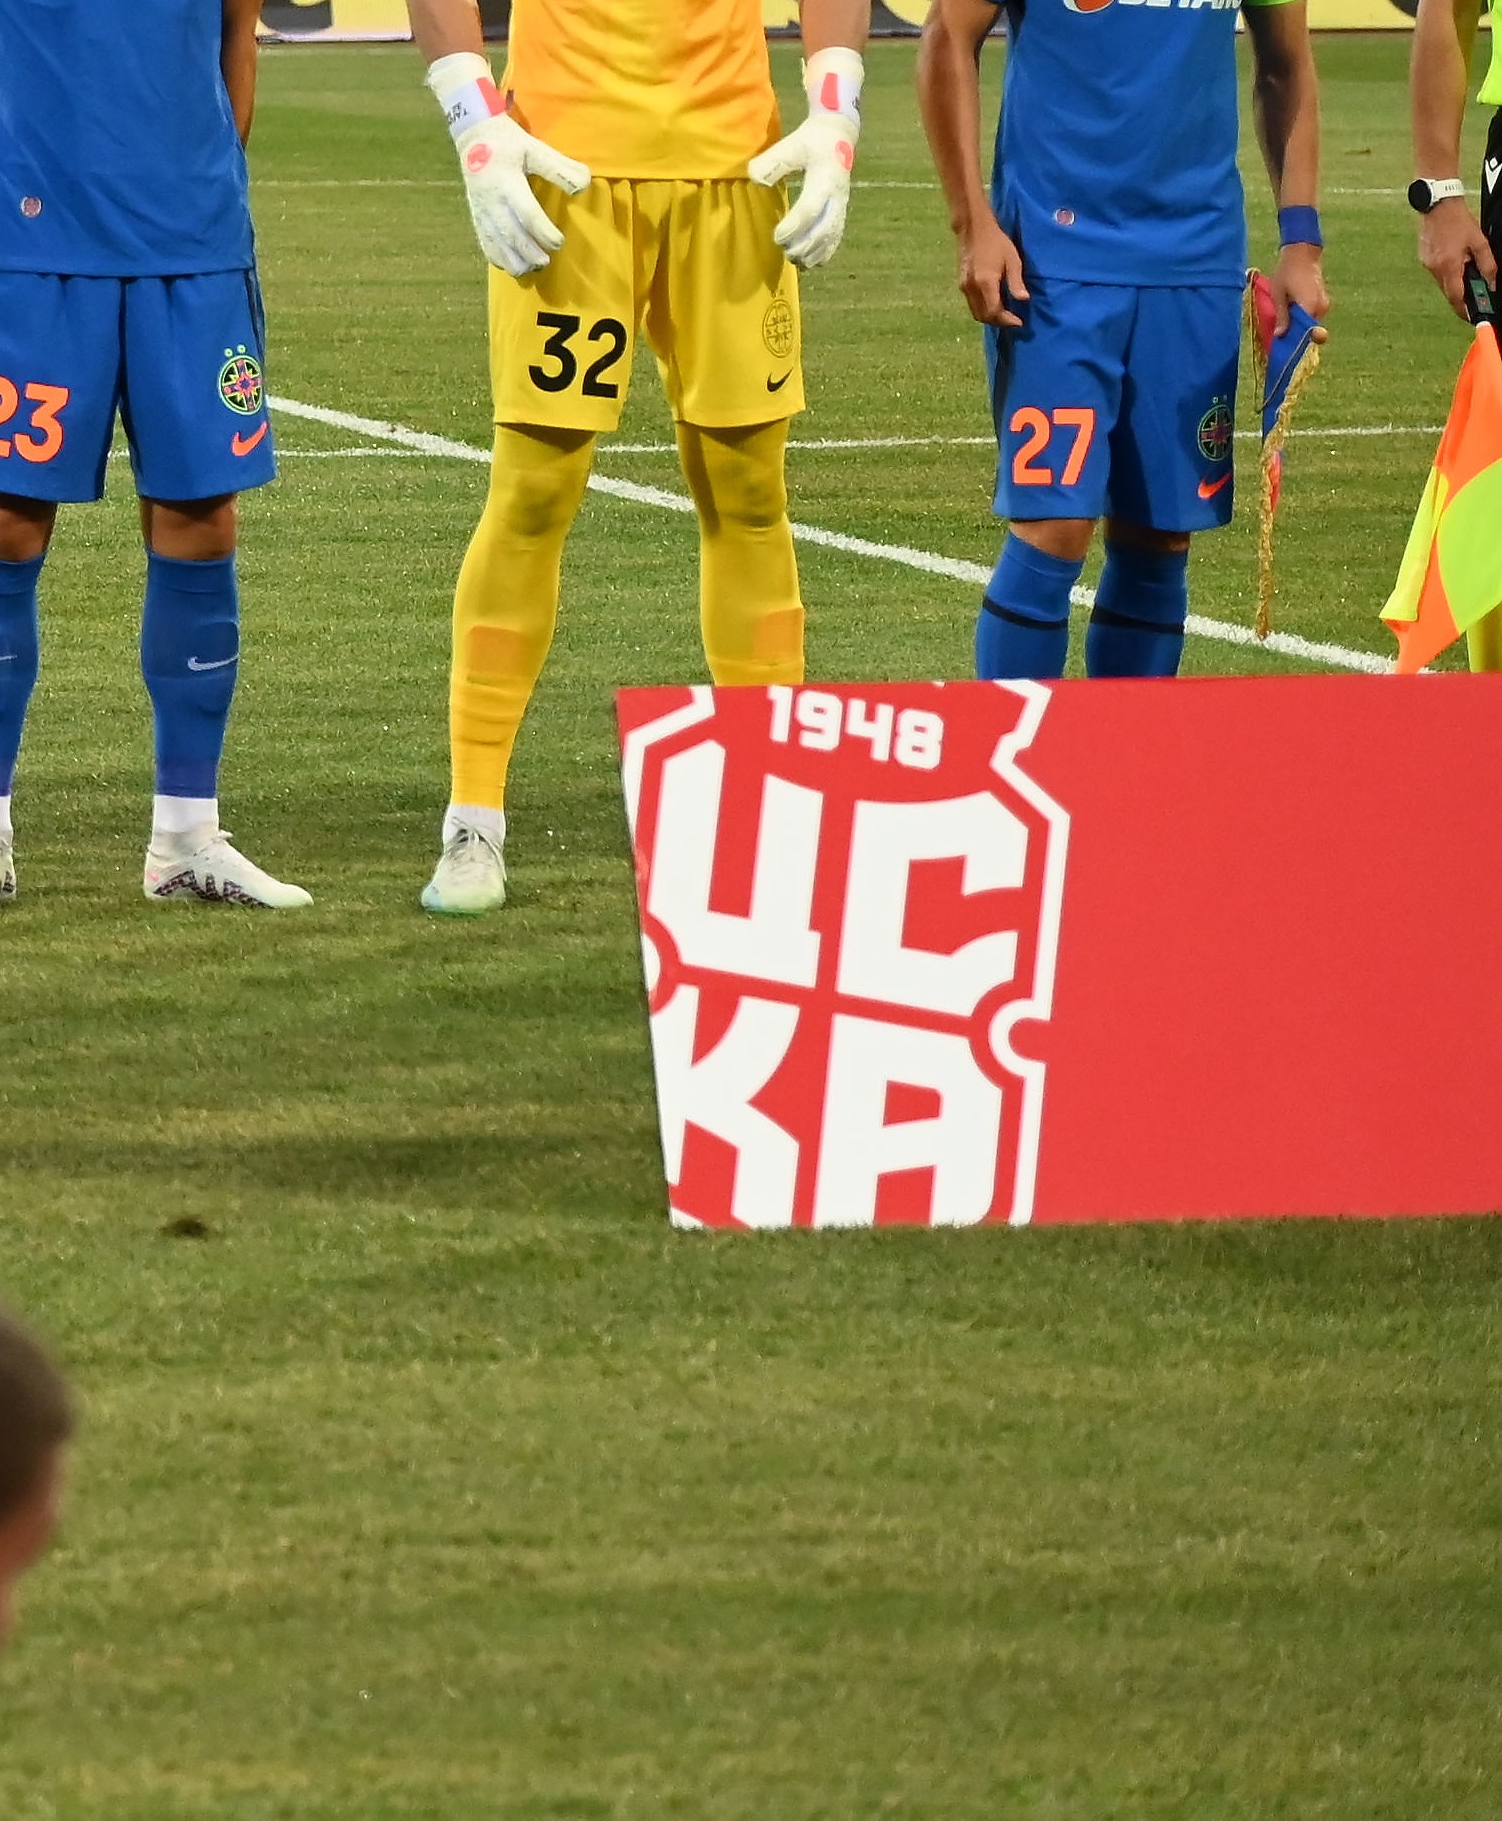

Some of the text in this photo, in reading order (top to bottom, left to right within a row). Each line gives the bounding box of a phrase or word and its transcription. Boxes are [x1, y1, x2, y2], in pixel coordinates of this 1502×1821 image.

[528, 311, 628, 399] 32
[1009, 406, 1095, 486] 27
[767, 685, 944, 771] 1948
